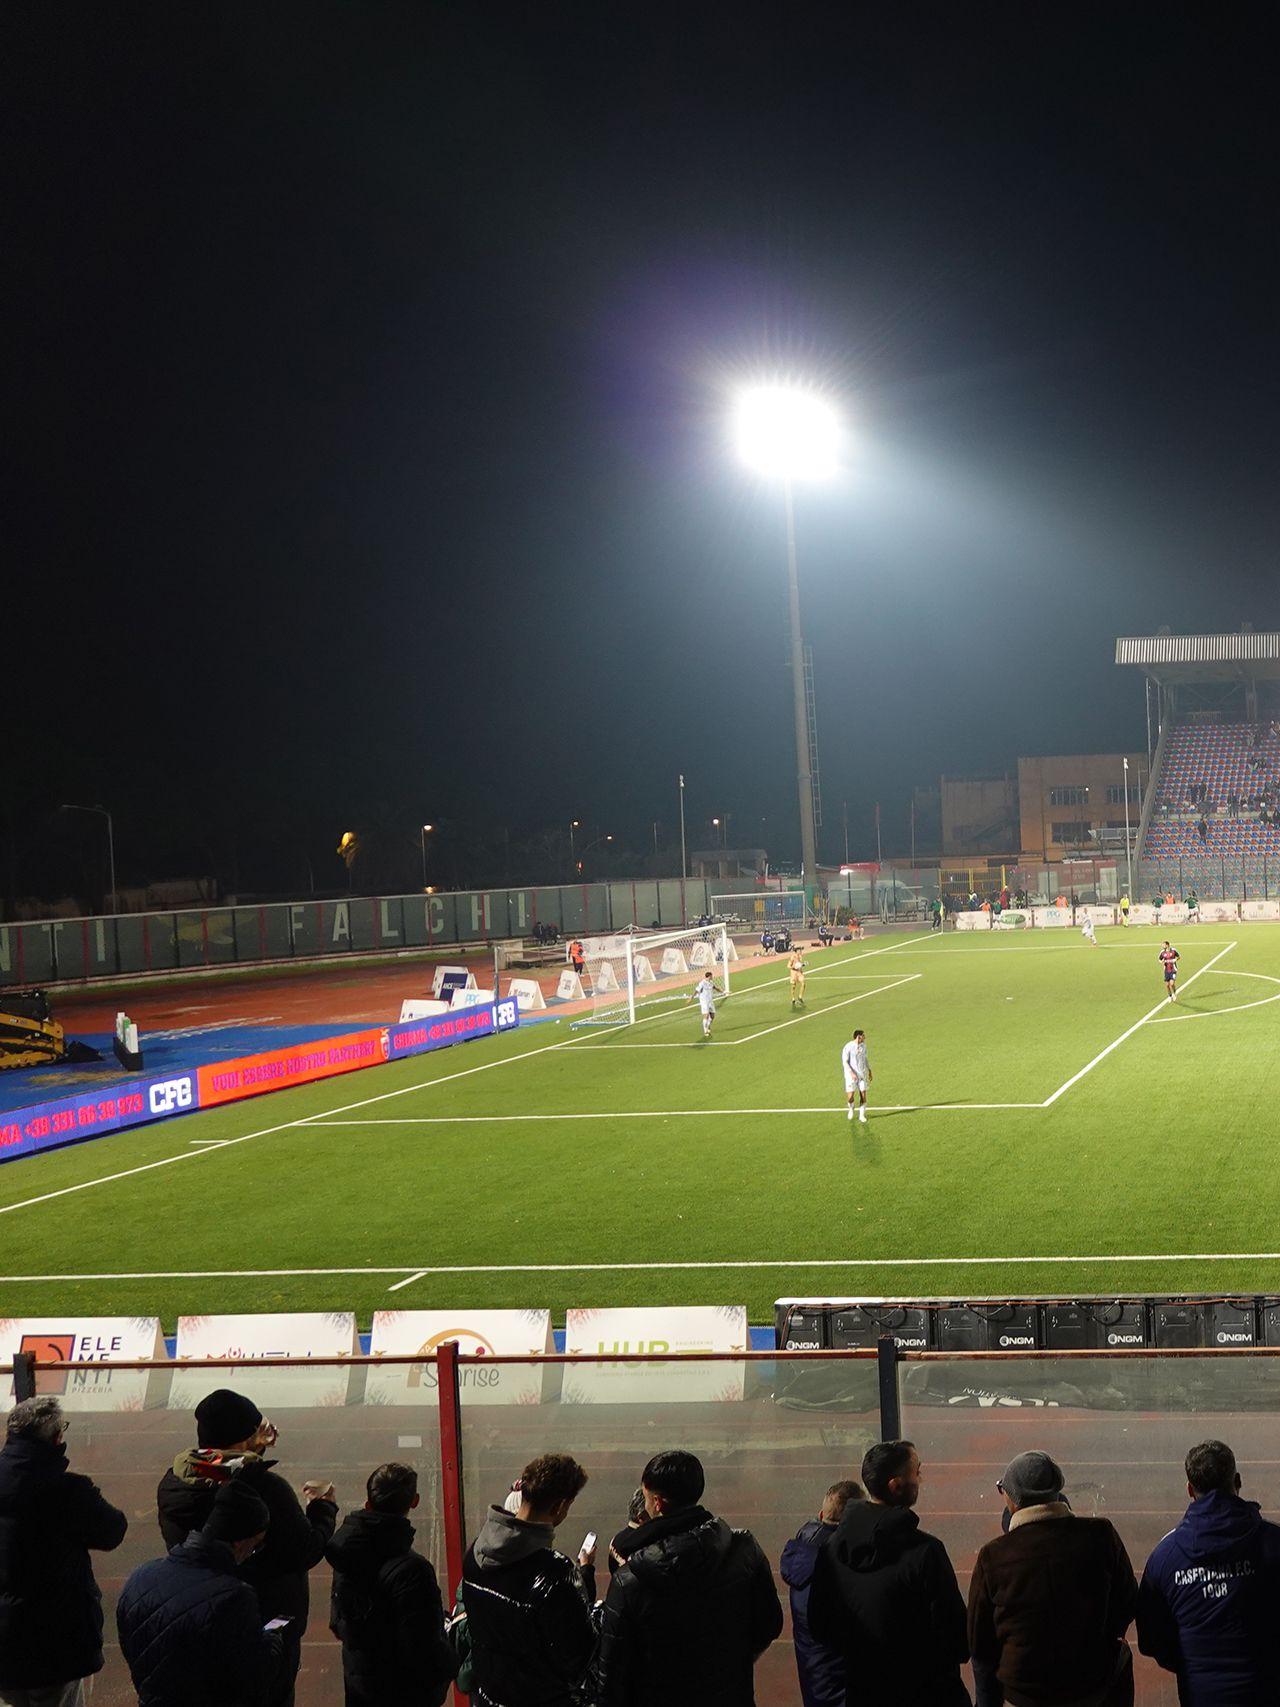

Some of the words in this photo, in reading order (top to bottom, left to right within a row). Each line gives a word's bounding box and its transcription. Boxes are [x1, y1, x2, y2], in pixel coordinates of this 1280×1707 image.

[287, 892, 527, 945] FALCHI
[52, 1109, 76, 1133] 331
[1009, 1337, 1034, 1345] NGM
[1117, 1334, 1143, 1343] NGM
[1226, 1333, 1252, 1342] NGM
[80, 1336, 122, 1351] ELE
[795, 1341, 820, 1350] NGM
[901, 1338, 926, 1347] NGM
[71, 1385, 113, 1394] PIZZERIA
[1202, 1582, 1228, 1599] 1908
